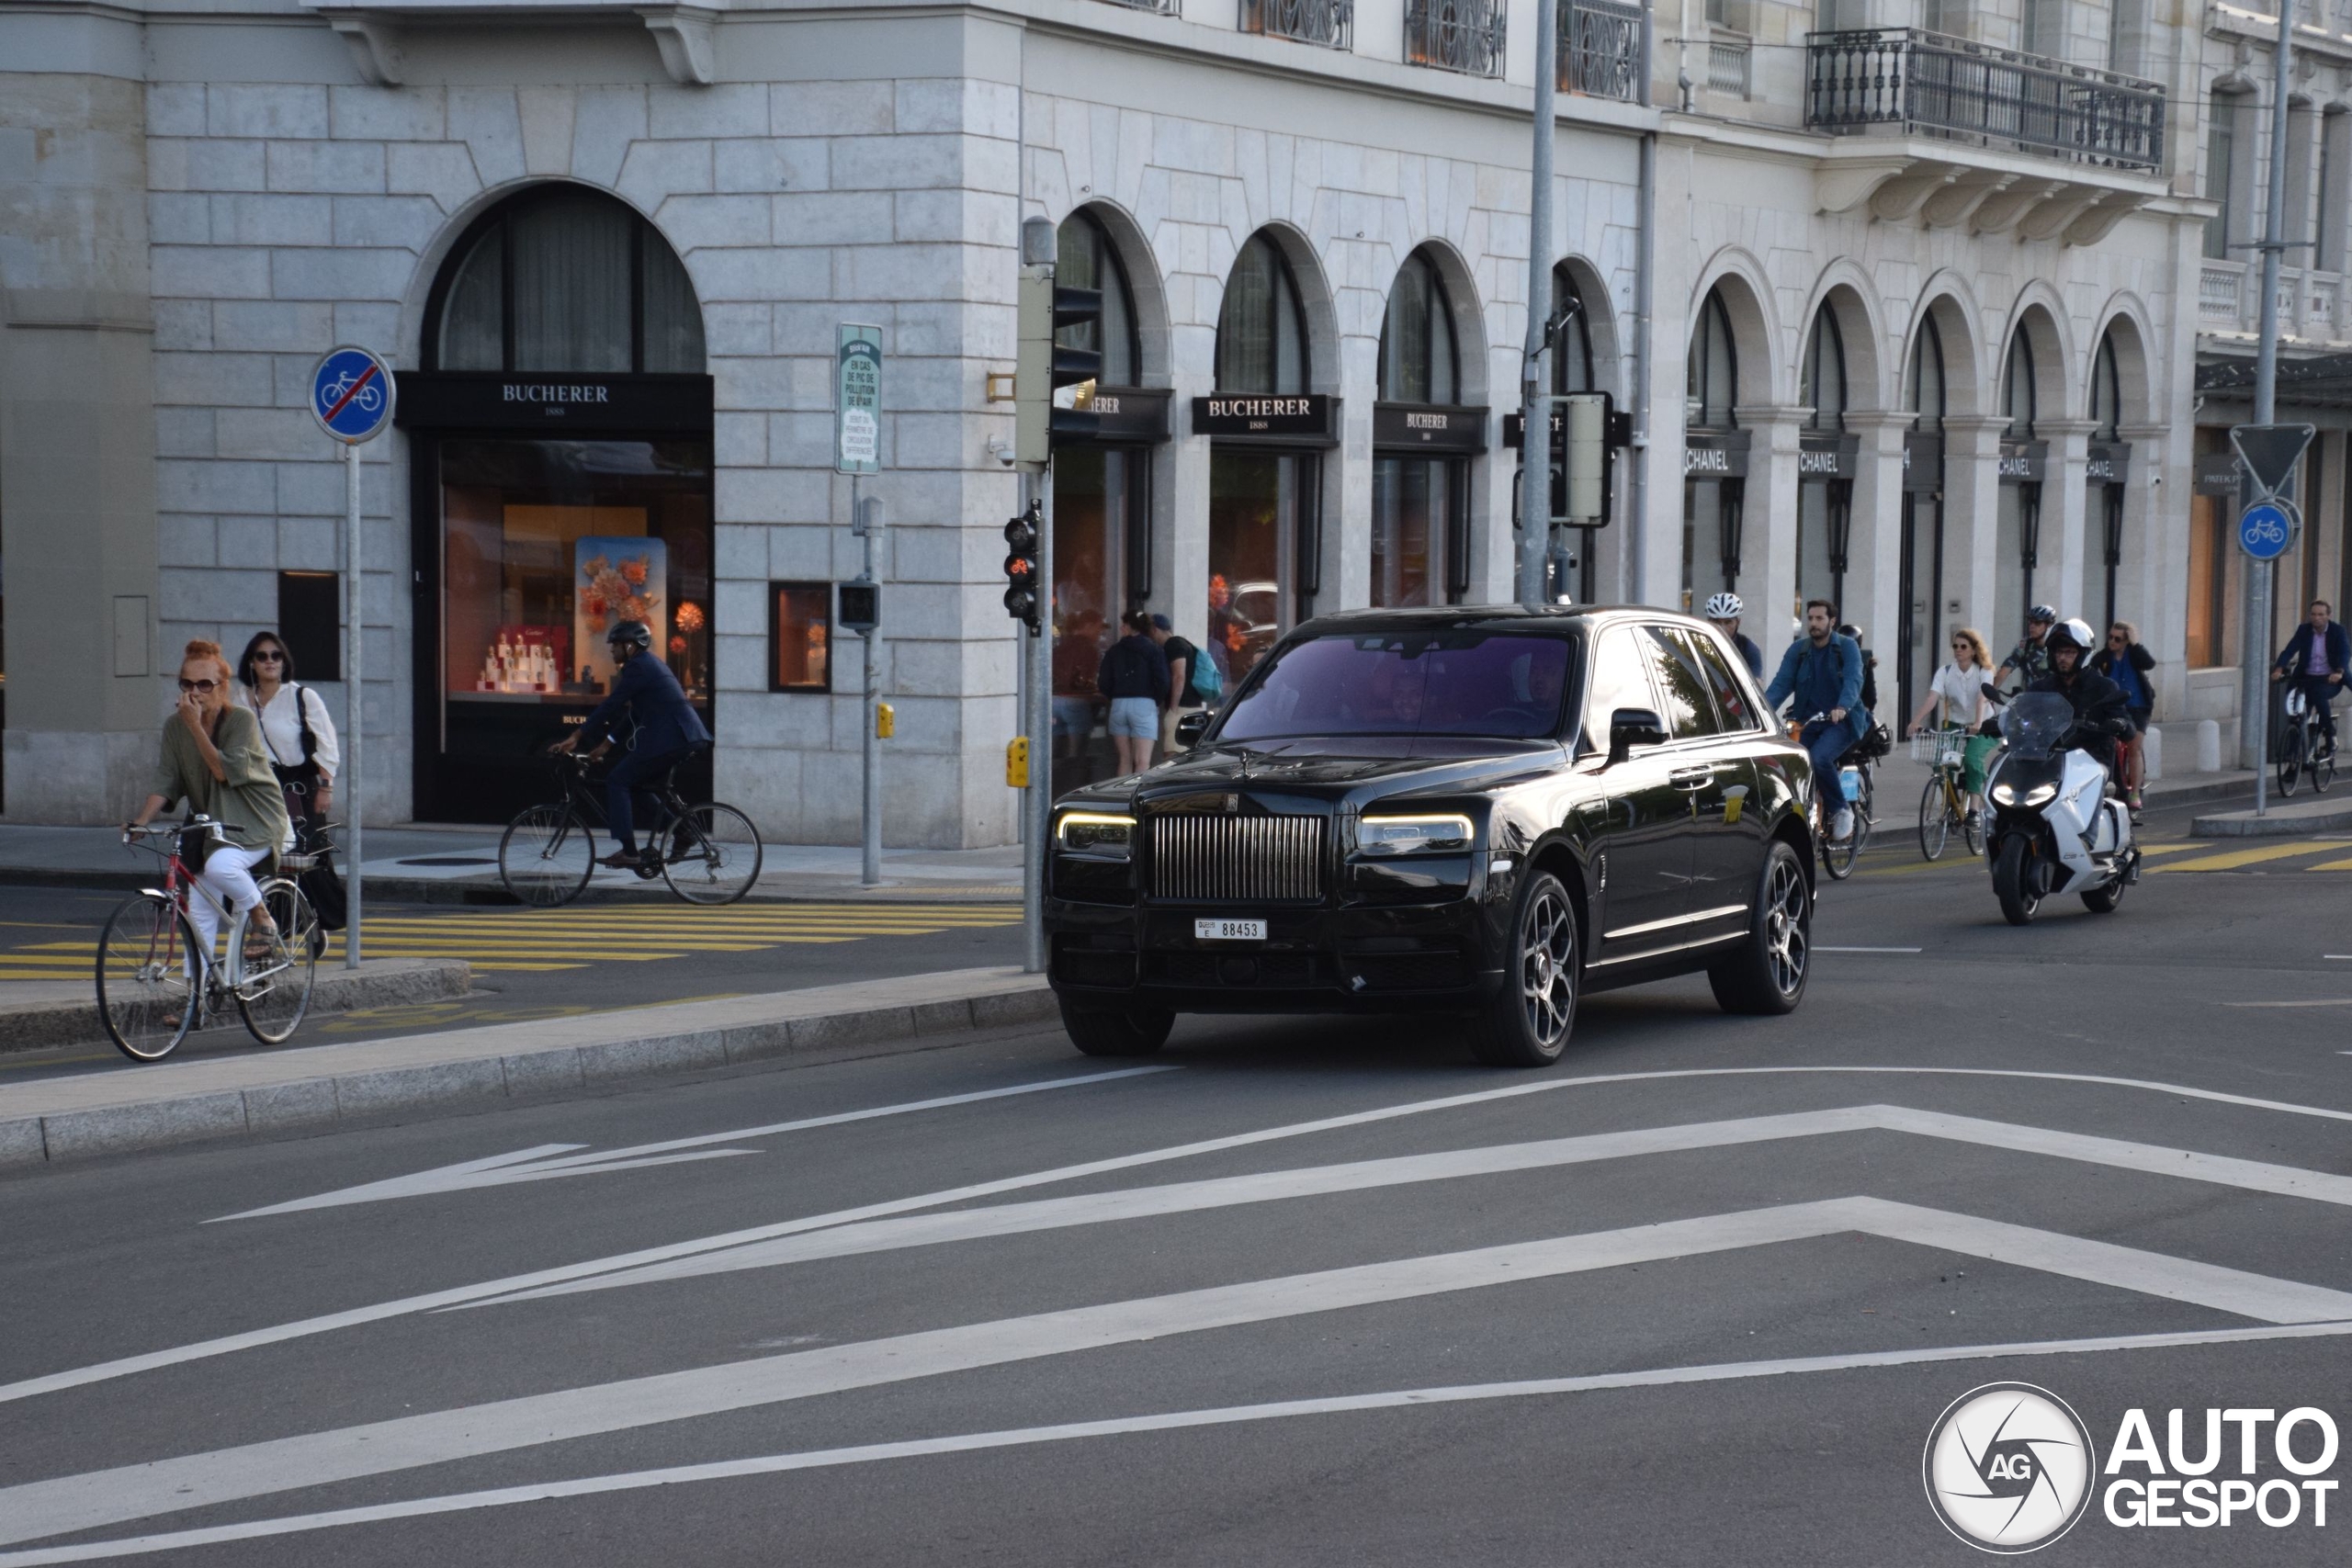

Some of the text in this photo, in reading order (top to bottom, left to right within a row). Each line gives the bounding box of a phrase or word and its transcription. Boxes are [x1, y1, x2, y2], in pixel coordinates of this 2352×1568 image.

[851, 360, 871, 371] EN CAS
[847, 371, 874, 384] DE PIC DE
[503, 384, 608, 402] BUCHERER
[845, 383, 875, 395] POLLUTION
[847, 396, 855, 406] DE
[1208, 399, 1310, 417] BUCHERER
[1250, 421, 1269, 430] 1888
[1407, 412, 1448, 429] BUCHERER
[1686, 449, 1729, 471] CHANEL
[1800, 453, 1838, 473] CHANEL
[2205, 475, 2232, 484] PATEK
[1204, 930, 1210, 938] E
[1222, 922, 1258, 937] 88453
